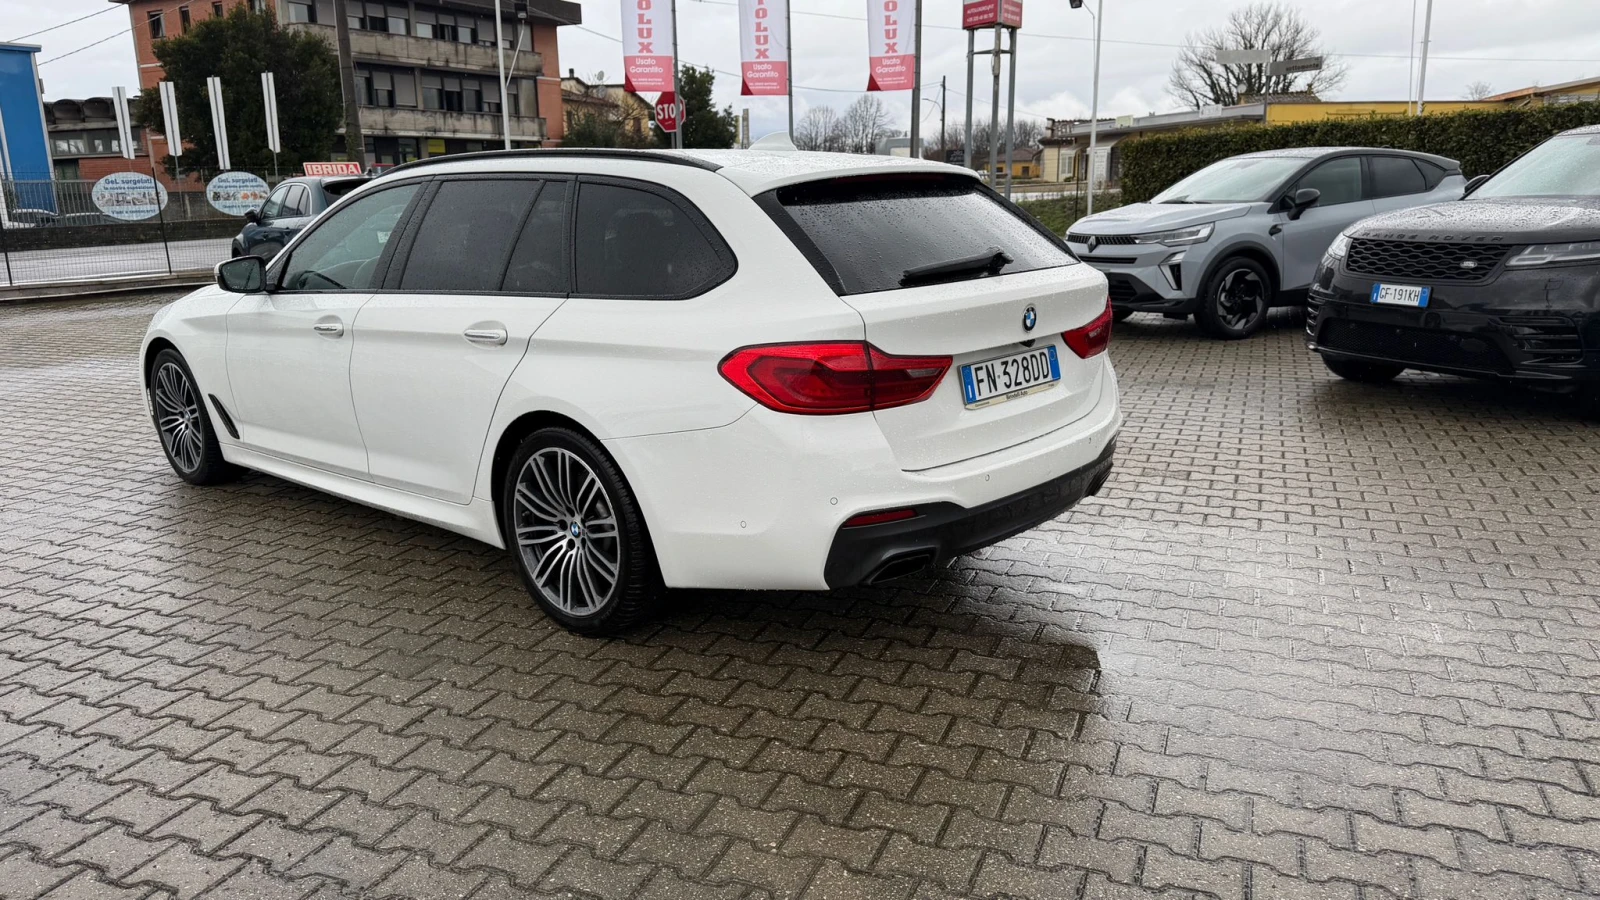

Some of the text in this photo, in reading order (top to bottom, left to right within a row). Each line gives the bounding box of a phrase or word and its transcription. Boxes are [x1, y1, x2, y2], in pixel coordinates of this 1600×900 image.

[876, 65, 906, 73] Garantito
[307, 164, 359, 175] IBRIDA
[121, 177, 152, 186] surgelati
[1361, 231, 1504, 242] RANGE ROVER
